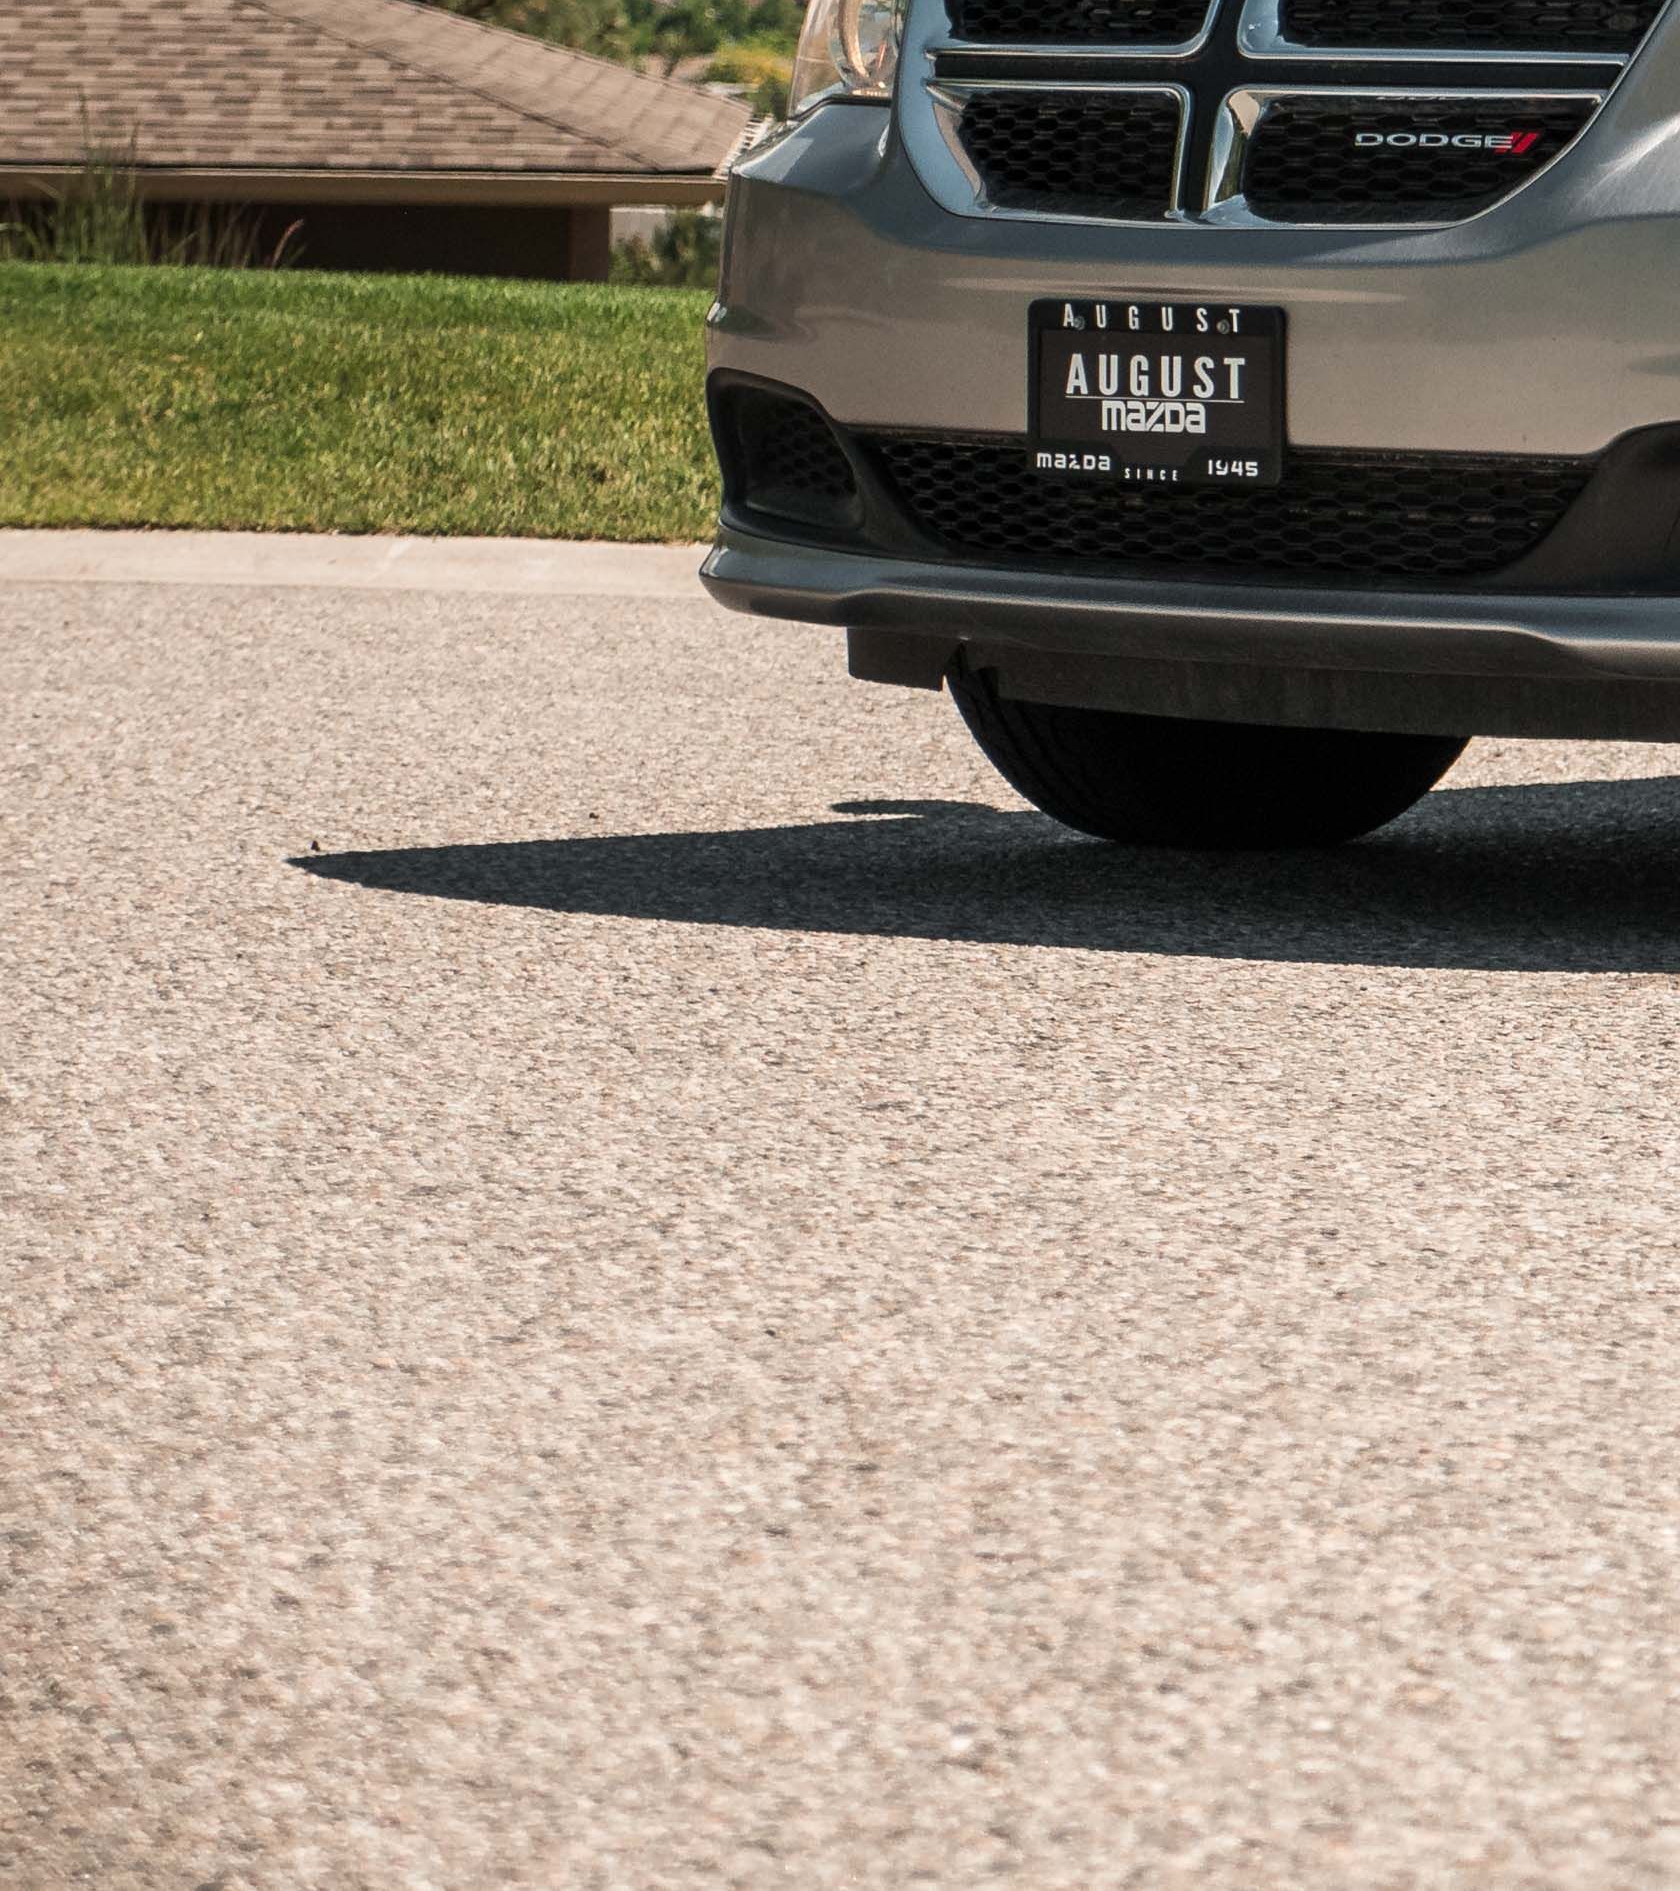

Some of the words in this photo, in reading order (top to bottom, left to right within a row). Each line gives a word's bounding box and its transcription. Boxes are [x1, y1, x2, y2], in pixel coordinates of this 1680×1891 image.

[1354, 132, 1514, 150] DODGE
[1062, 303, 1240, 334] AUGUST
[1065, 353, 1246, 399] AUGUST
[1101, 400, 1207, 434] mazda
[1036, 451, 1111, 471] mazda
[1124, 467, 1179, 482] SINCE
[1207, 458, 1259, 478] 1945
